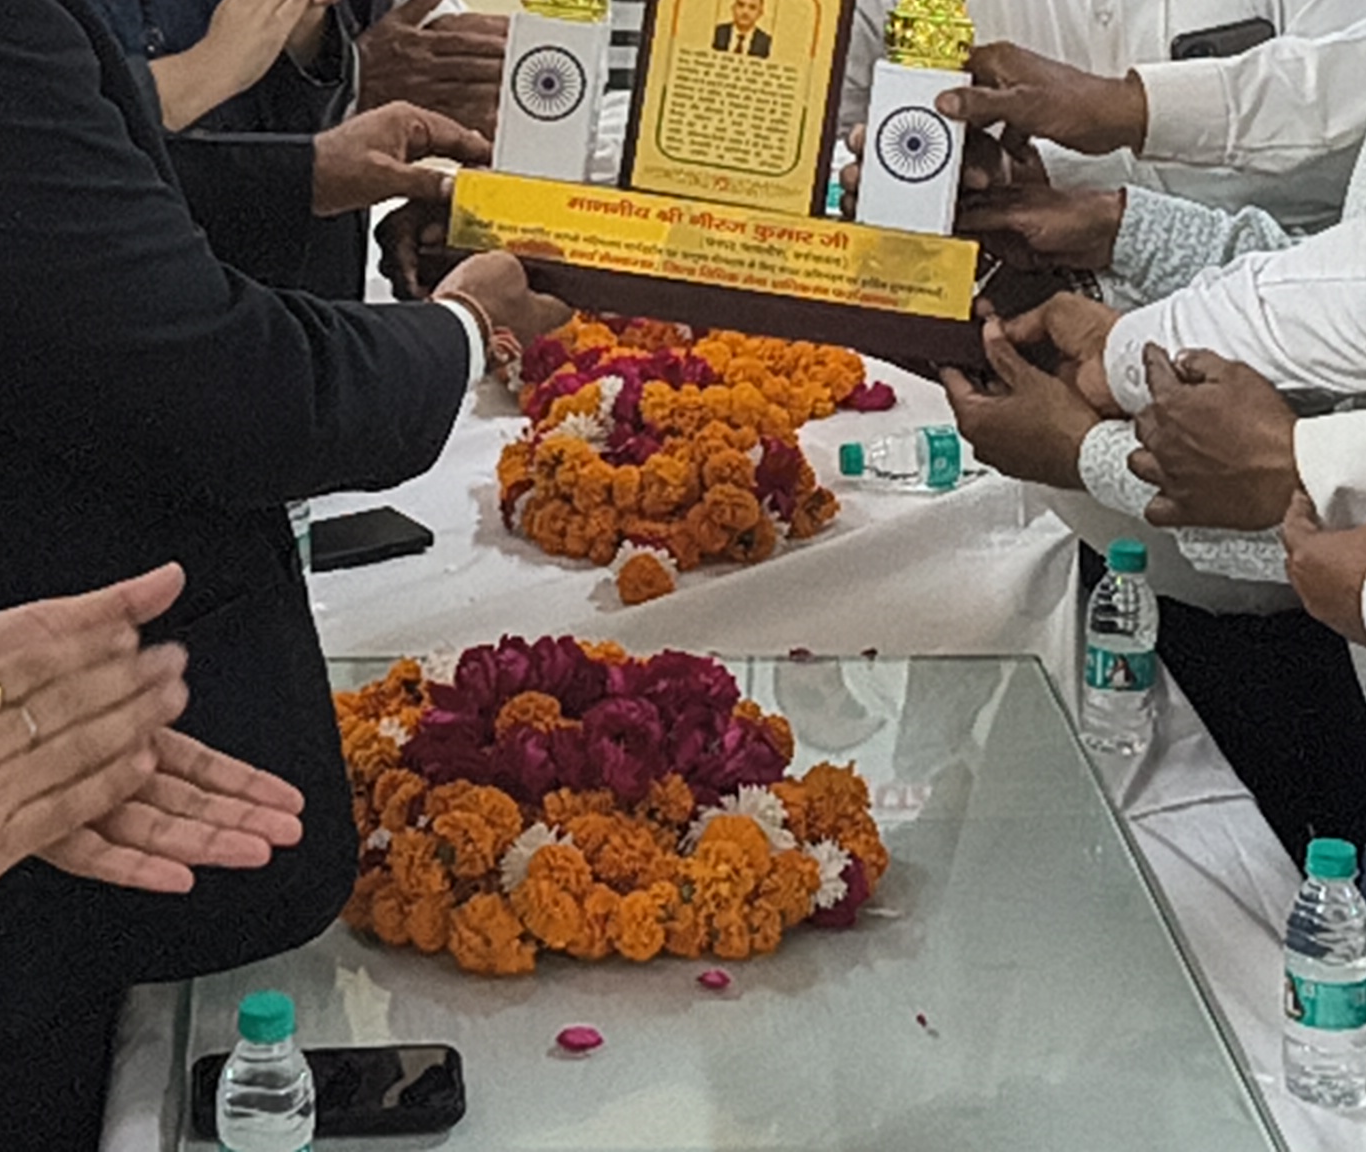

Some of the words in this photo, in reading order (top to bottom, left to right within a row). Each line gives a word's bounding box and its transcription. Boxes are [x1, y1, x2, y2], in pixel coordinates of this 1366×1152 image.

[656, 206, 684, 225] श्री
[689, 209, 746, 235] नीरज
[751, 222, 815, 247] कुमार
[819, 230, 850, 251] जी
